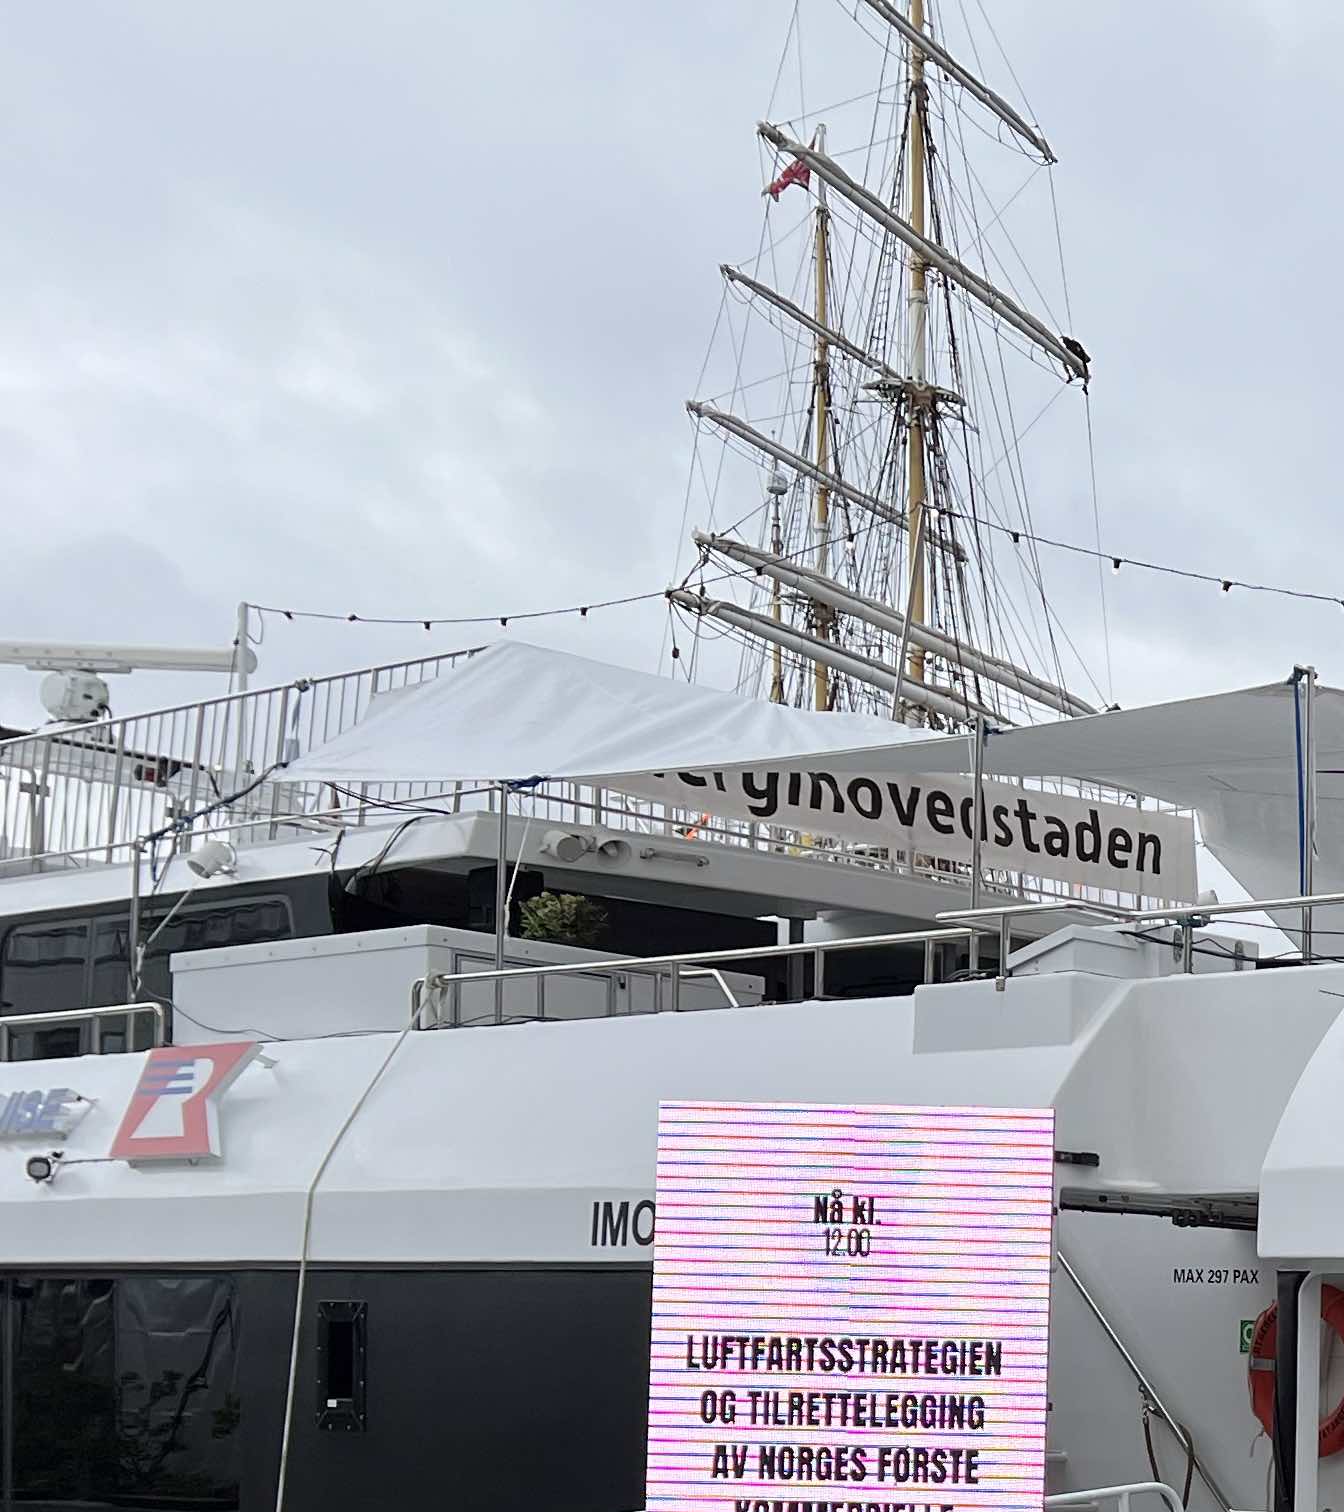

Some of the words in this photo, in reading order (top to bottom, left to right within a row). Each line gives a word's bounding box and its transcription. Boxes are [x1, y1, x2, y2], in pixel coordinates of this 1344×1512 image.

[591, 1199, 656, 1247] IMO
[814, 1188, 844, 1224] Nå
[1173, 1268, 1204, 1284] MAX
[1207, 1269, 1230, 1284] 297
[1232, 1269, 1260, 1285] PAX
[686, 1334, 1002, 1376] LUFTFARTSSTRATEGIEN
[700, 1390, 736, 1424] OG
[746, 1390, 986, 1430] TILRETTELEGGING
[712, 1444, 748, 1479] AV
[758, 1446, 867, 1482] NORGES
[877, 1446, 979, 1485] FØRSTE
